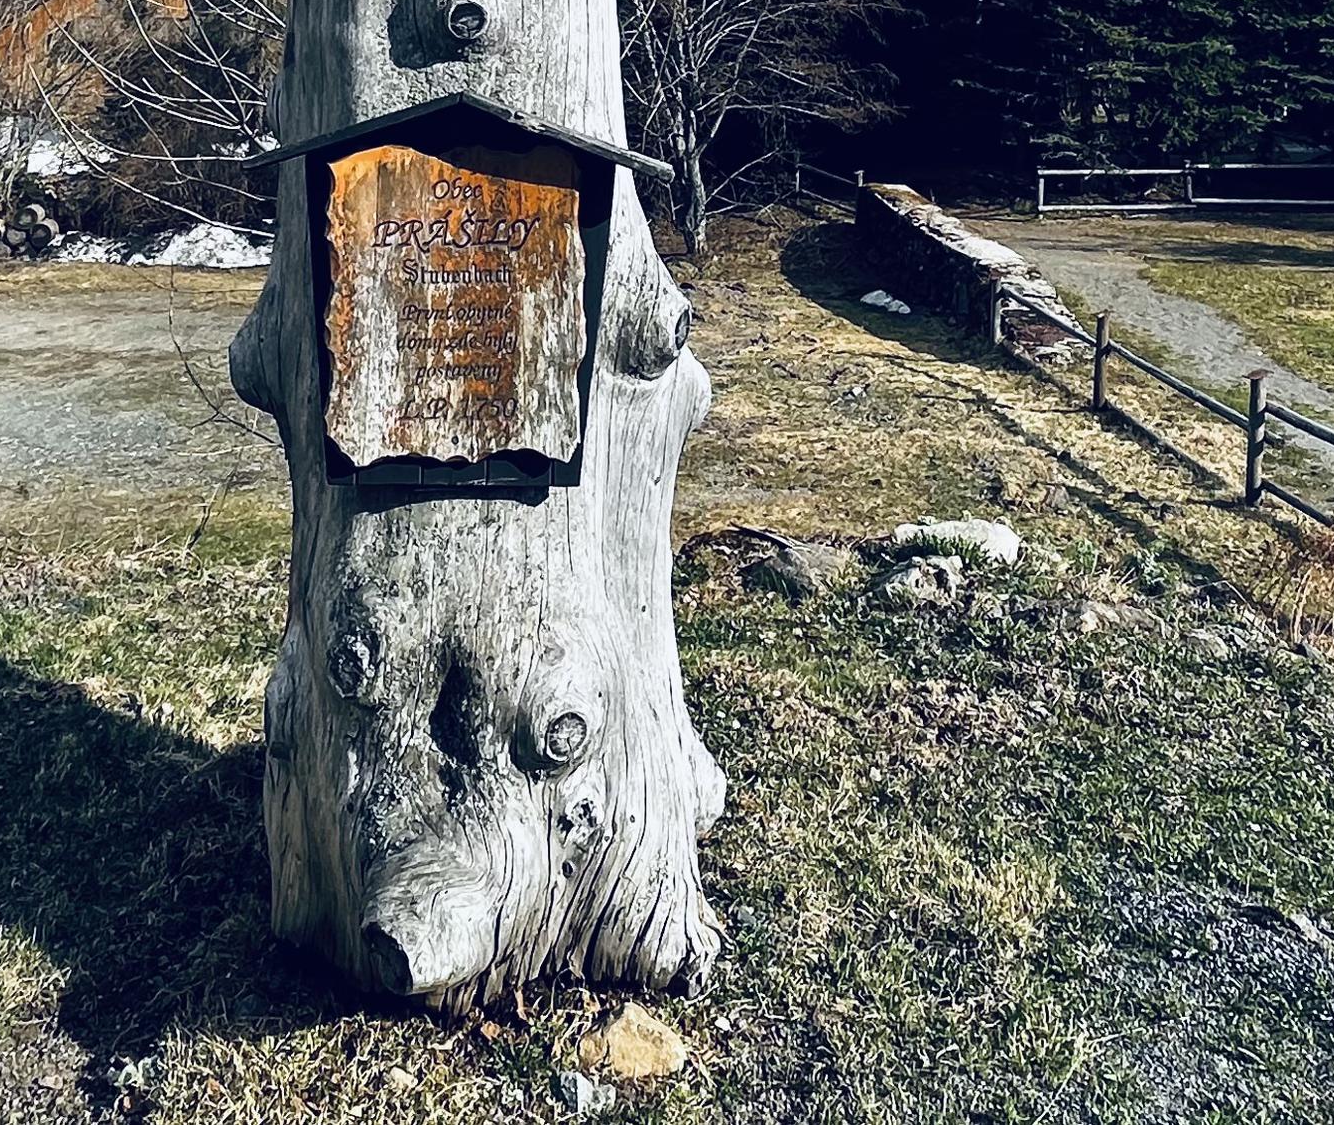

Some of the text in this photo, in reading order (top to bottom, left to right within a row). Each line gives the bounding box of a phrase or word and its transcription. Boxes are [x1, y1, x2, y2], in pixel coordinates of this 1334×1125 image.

[432, 177, 483, 199] Obec
[371, 210, 540, 253] PRÁŠILY
[402, 258, 513, 285] Stubenbach
[455, 301, 513, 323] obytné
[397, 331, 518, 355] domy zde byly
[416, 362, 502, 385] postaveny
[463, 397, 518, 421] 1750
